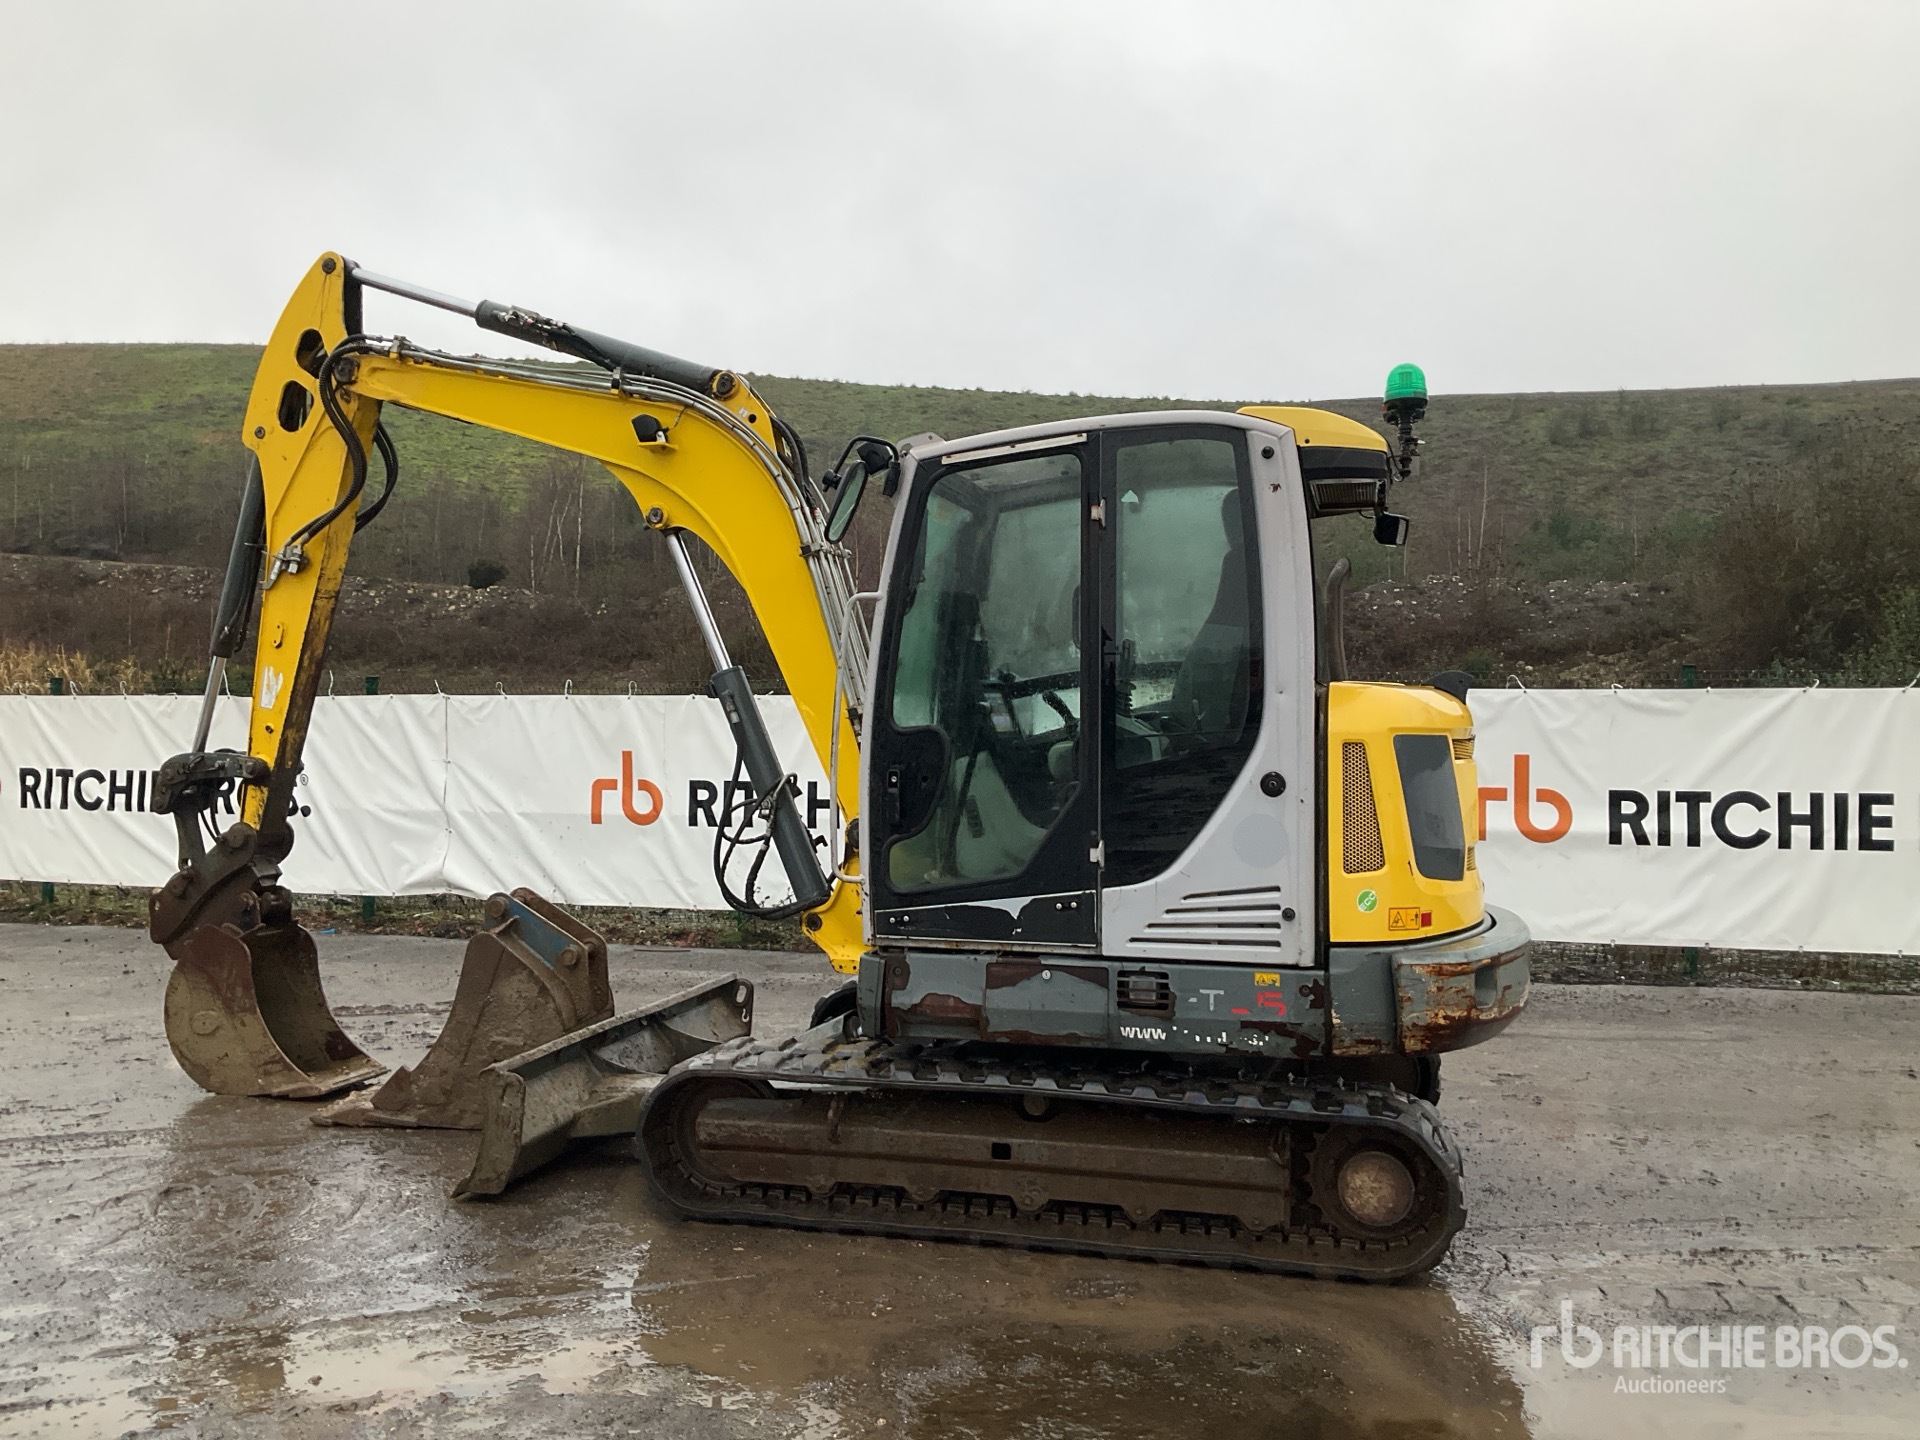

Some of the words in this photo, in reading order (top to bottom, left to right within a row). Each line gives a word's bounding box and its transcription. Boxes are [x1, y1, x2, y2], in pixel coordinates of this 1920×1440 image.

[19, 767, 160, 813] RITCHI
[591, 750, 664, 826] rb
[1477, 754, 1573, 844] rb
[1608, 789, 1895, 851] RITCHIE
